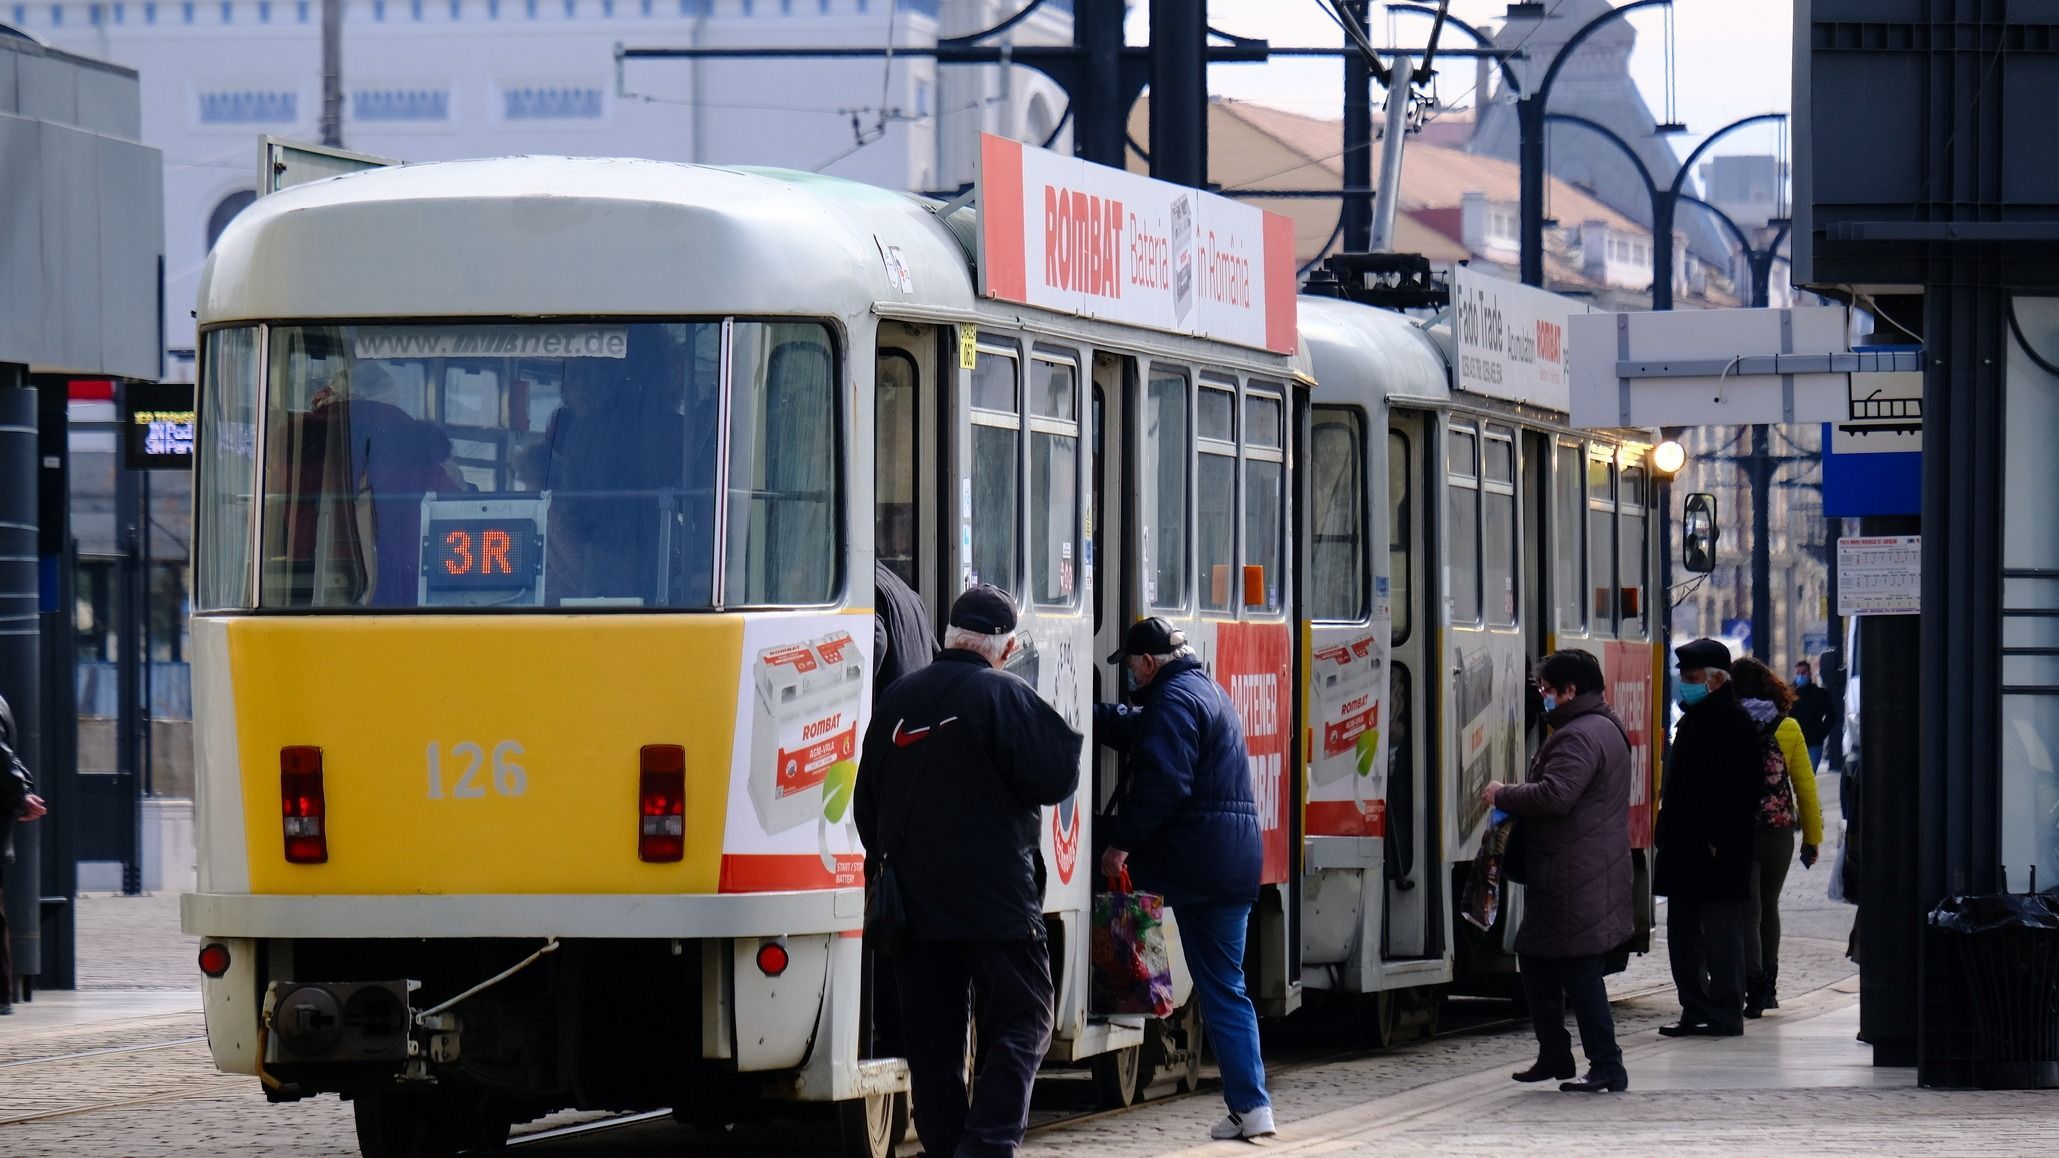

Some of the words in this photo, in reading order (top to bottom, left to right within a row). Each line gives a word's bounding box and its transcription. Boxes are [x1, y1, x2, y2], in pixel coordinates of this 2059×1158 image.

[1045, 184, 1123, 299] ROMBAT
[1130, 212, 1168, 290] Bateria
[1209, 230, 1250, 309] România
[1457, 284, 1478, 348] Fado
[1479, 290, 1503, 353] Trade
[1507, 324, 1535, 364] Acumulatori
[1536, 319, 1561, 365] ROMBAT
[802, 713, 841, 740] ROMBAT
[1341, 694, 1369, 716] ROMBAT
[426, 739, 528, 799] 126
